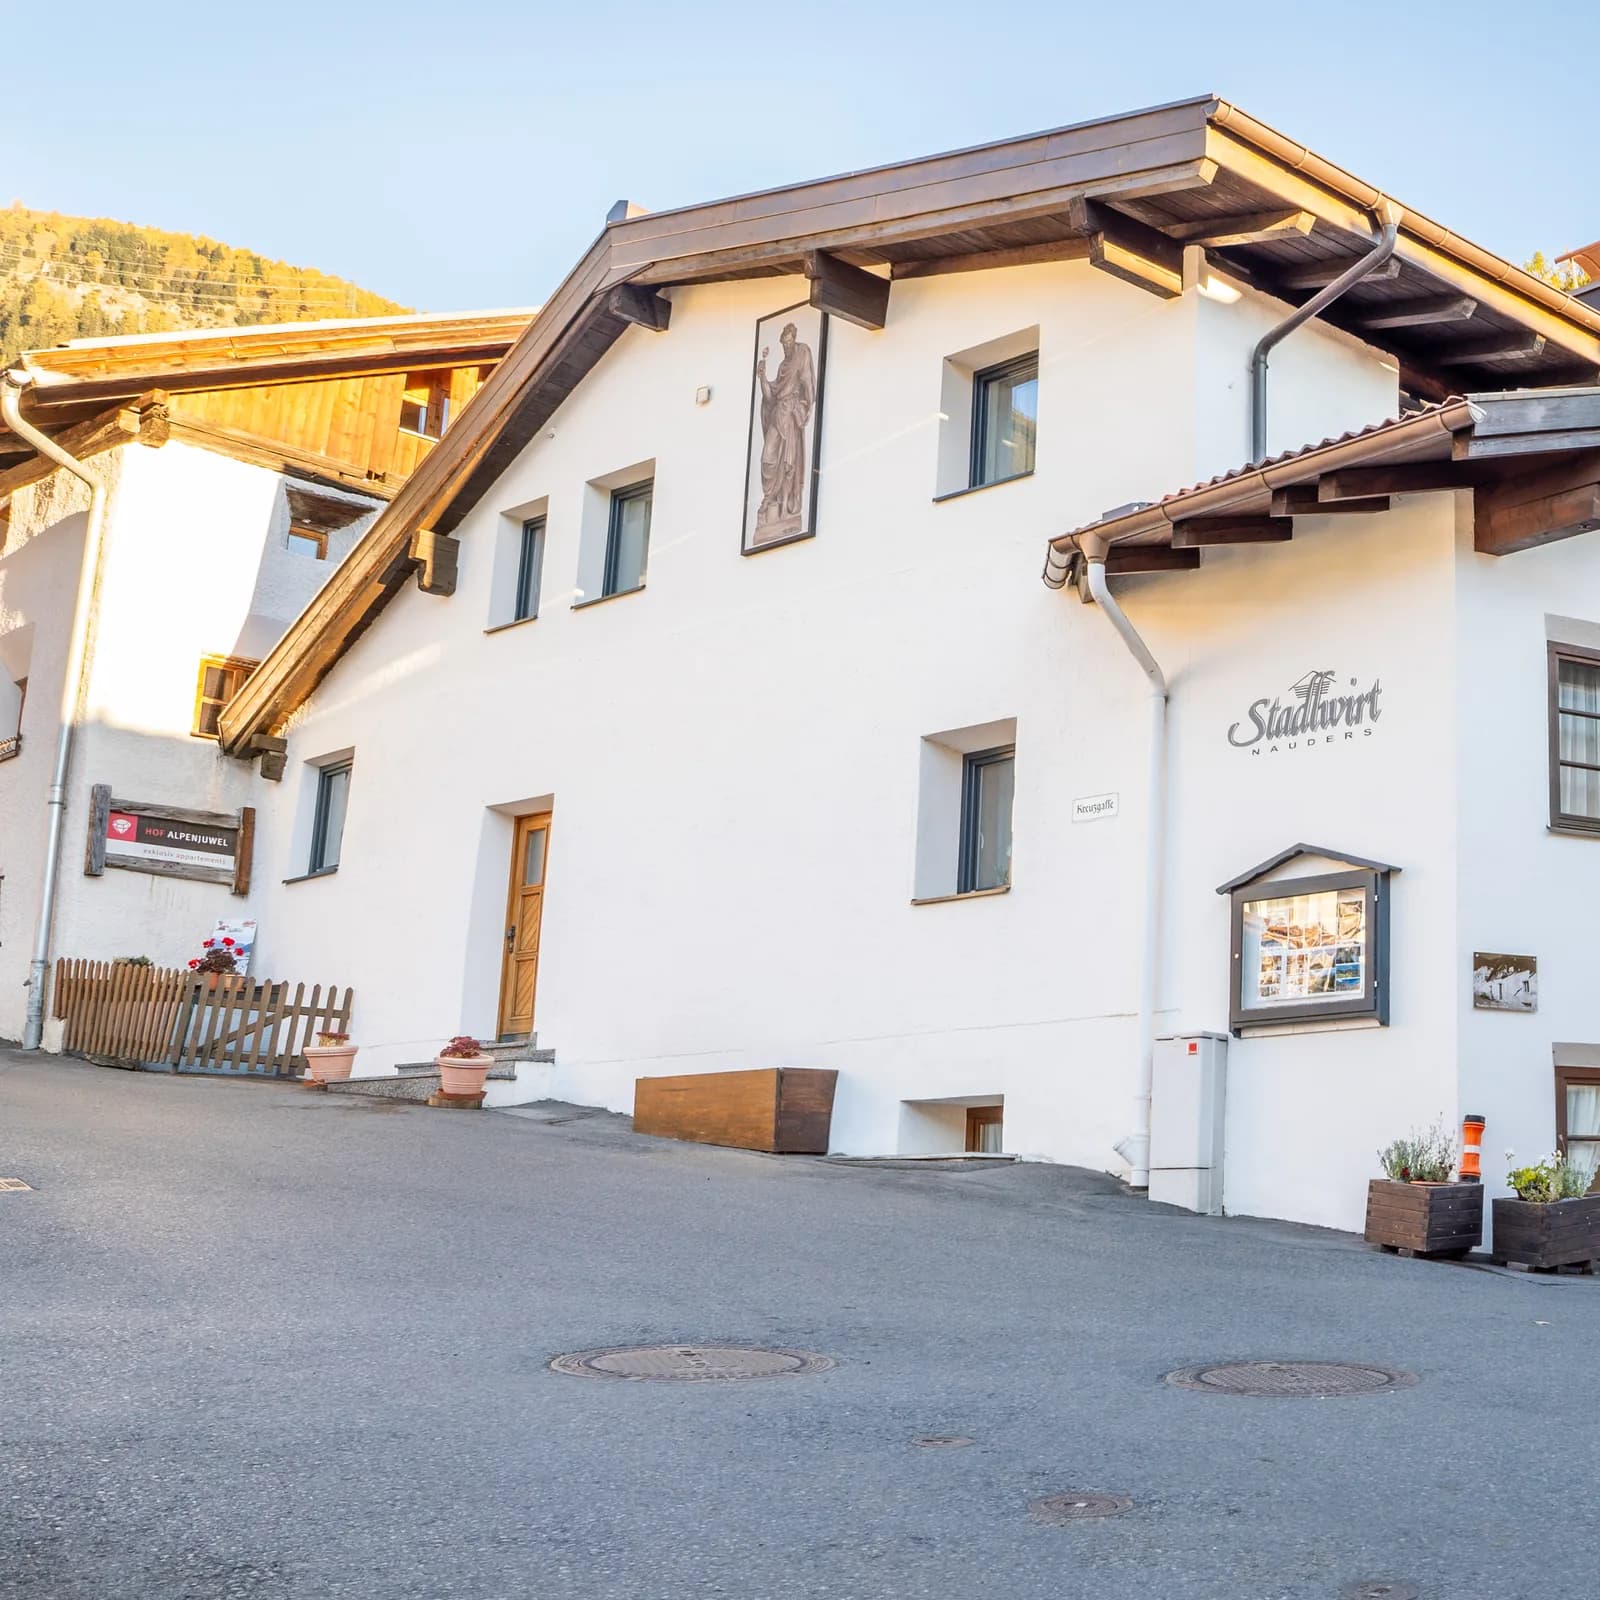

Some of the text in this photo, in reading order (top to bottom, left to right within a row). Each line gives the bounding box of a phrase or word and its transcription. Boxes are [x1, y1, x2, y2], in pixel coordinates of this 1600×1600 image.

[1228, 671, 1382, 747] Stadlwirt
[1251, 728, 1373, 756] NAUDERS
[144, 827, 229, 847] HOF ALPENJUWEL
